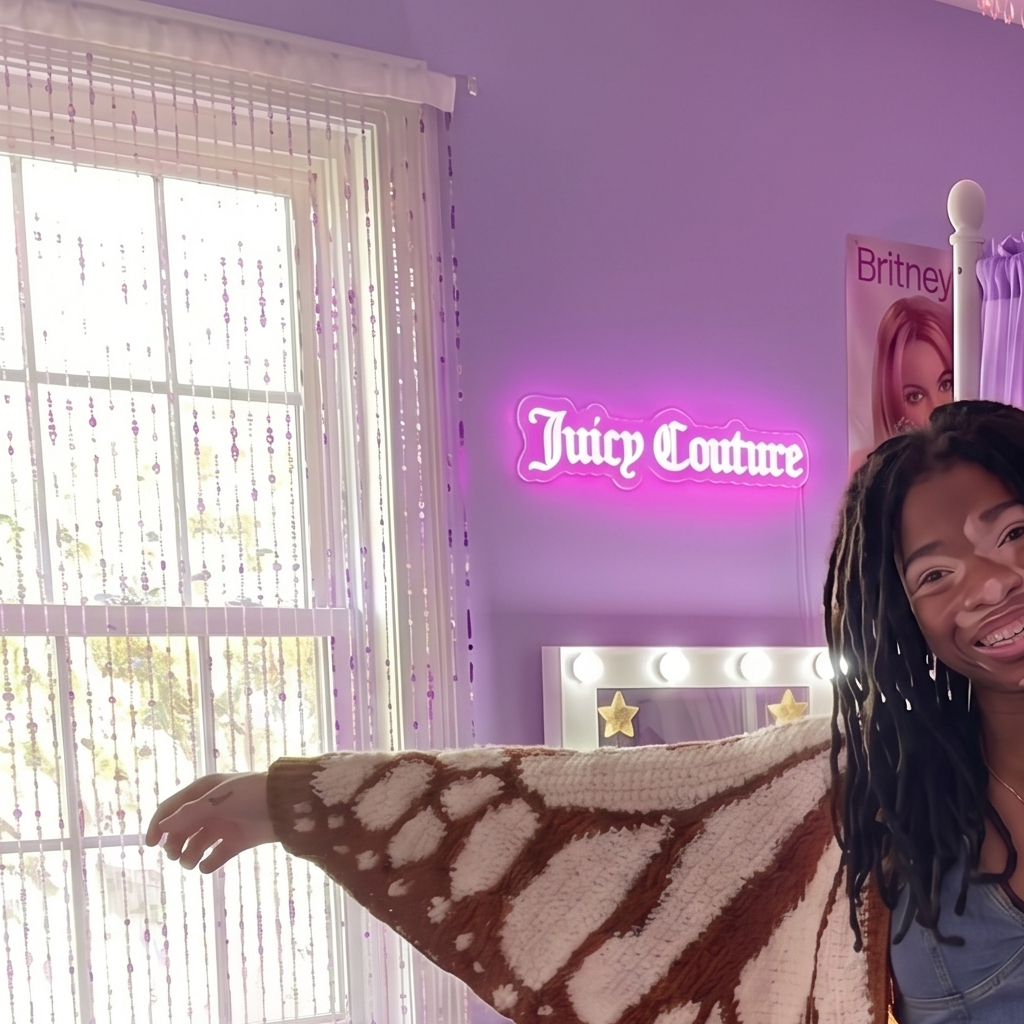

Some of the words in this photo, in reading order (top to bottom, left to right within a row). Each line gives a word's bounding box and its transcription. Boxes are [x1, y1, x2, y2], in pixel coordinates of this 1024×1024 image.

[858, 246, 952, 302] Britney
[528, 407, 644, 479] Juicy
[653, 420, 804, 478] Couture
